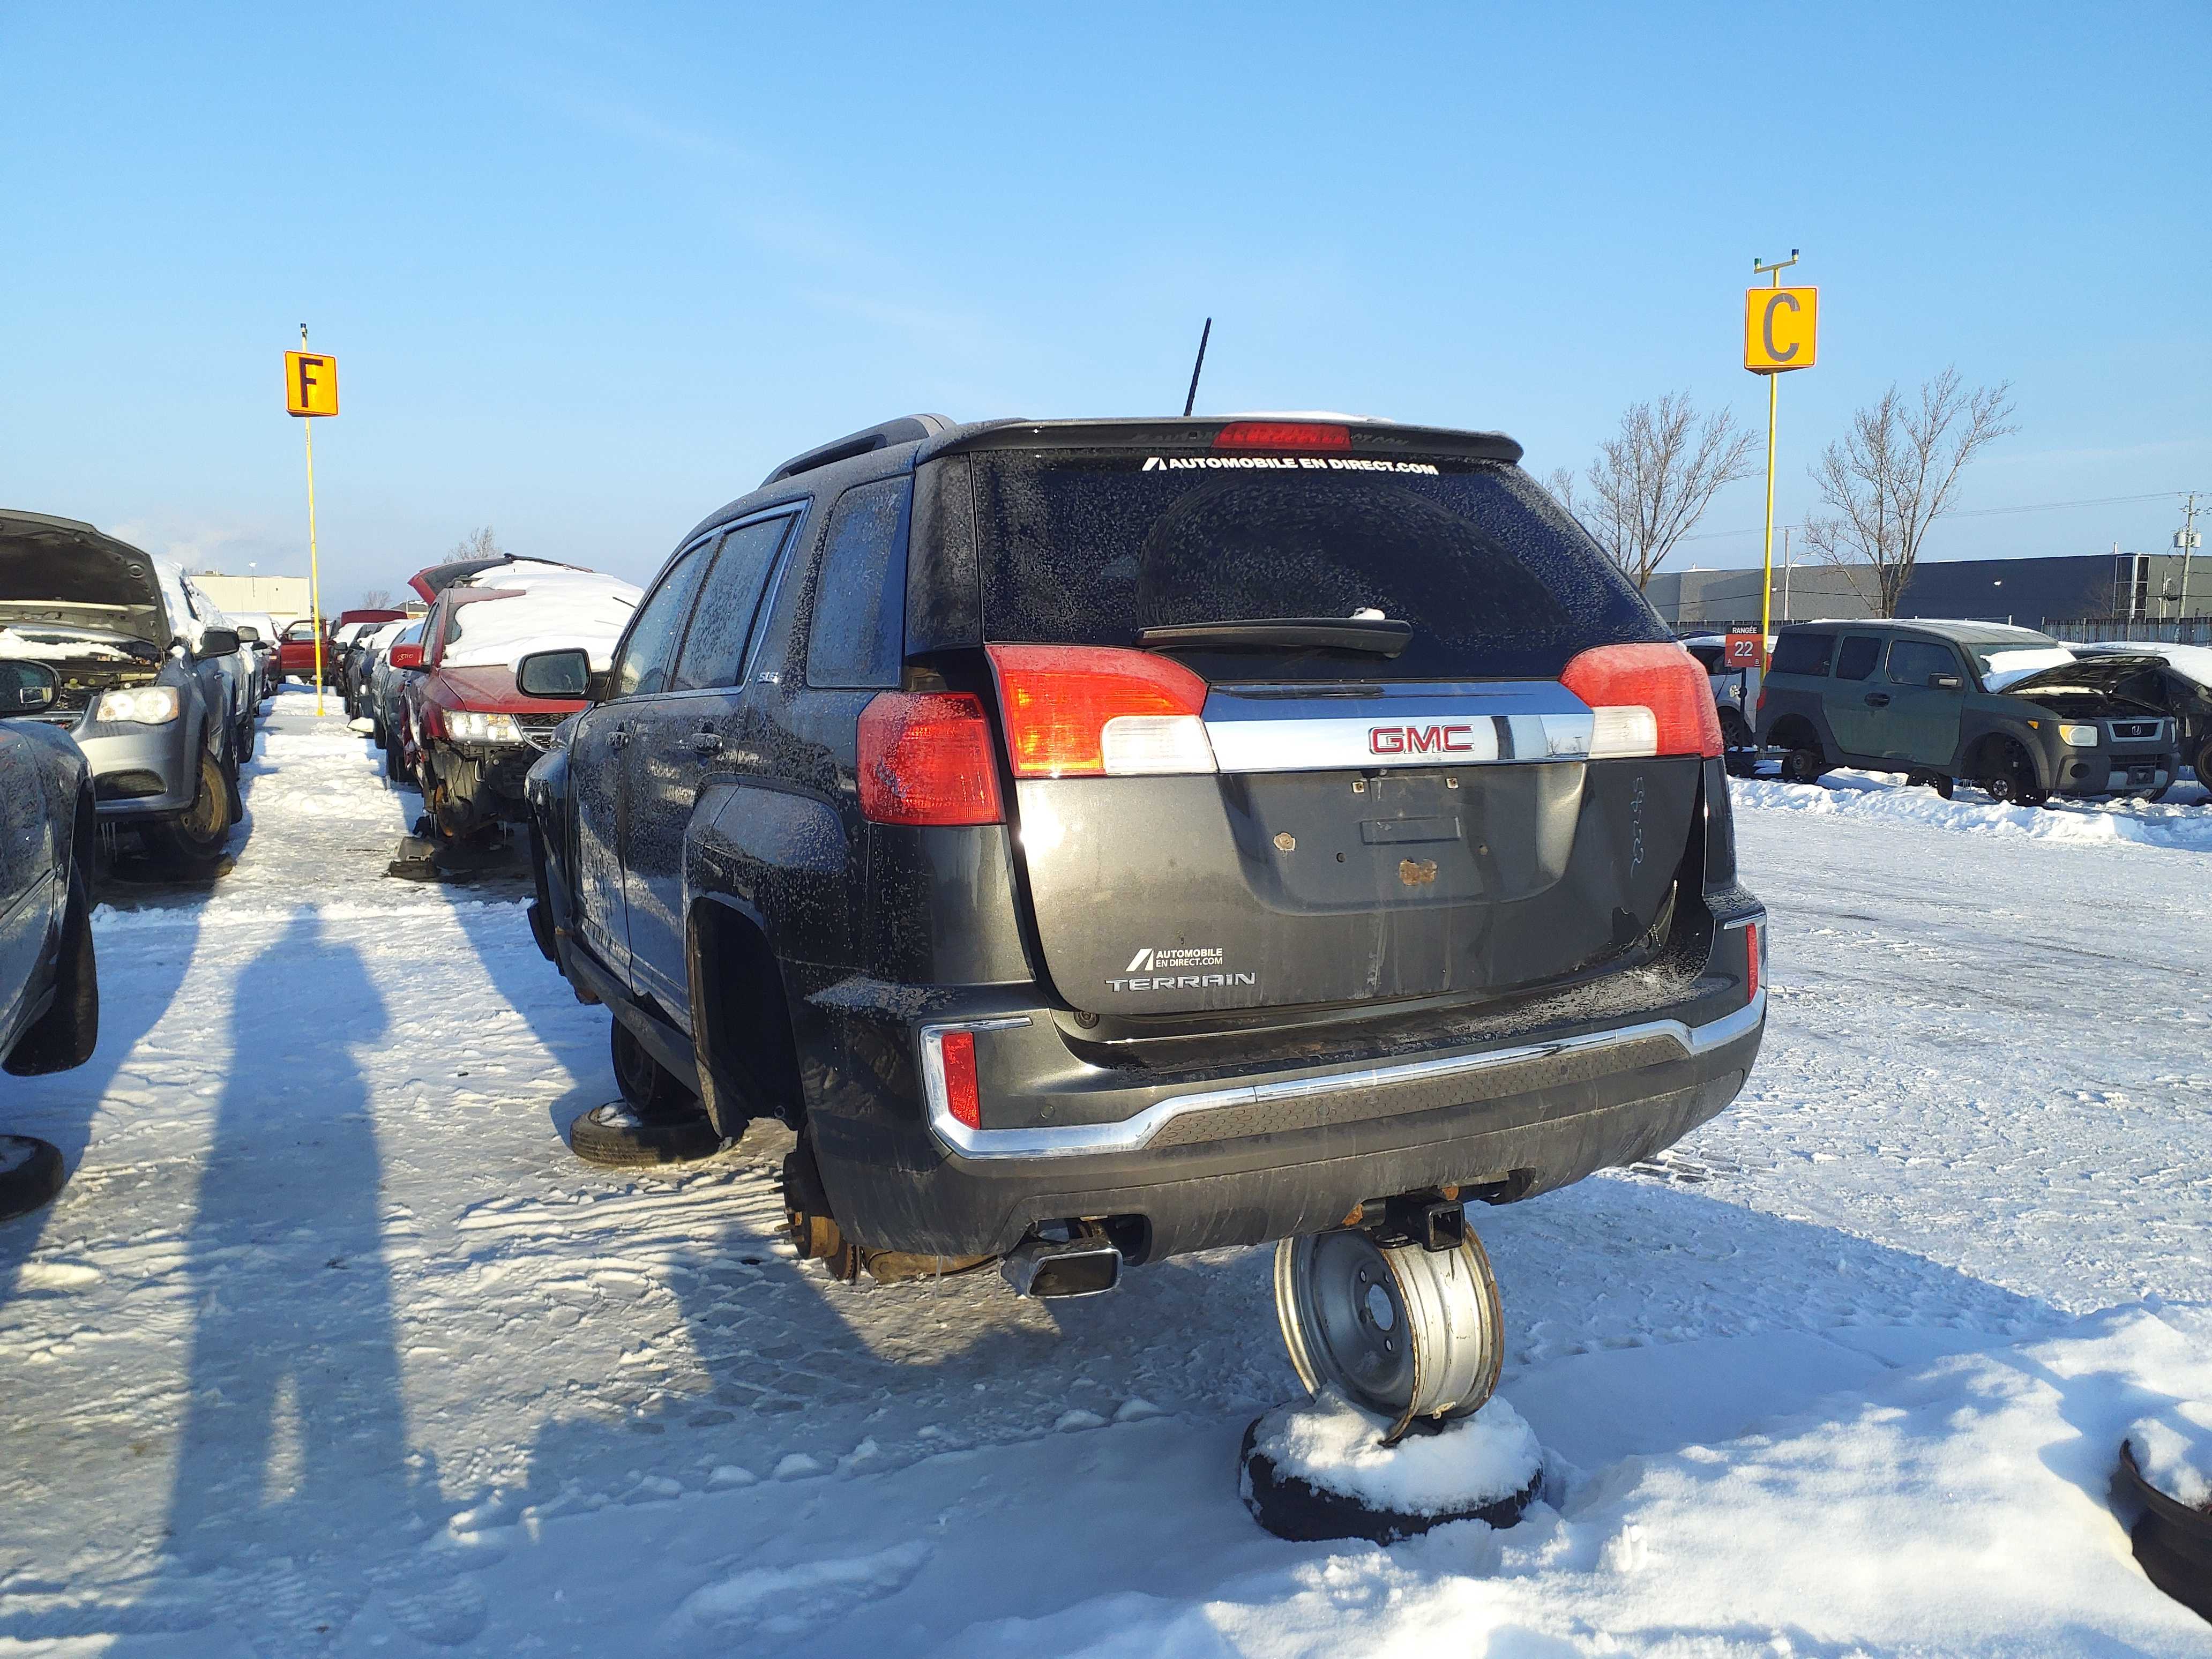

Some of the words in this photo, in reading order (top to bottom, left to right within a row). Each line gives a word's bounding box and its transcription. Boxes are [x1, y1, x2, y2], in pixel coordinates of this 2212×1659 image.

[1763, 293, 1800, 362] C
[298, 357, 324, 408] F
[1169, 458, 1298, 469] AUTOMOBILE
[1298, 459, 1328, 469] EN
[1327, 459, 1439, 475] DIRECT.COM
[1734, 641, 1753, 656] 22
[1369, 724, 1475, 754] GMC
[1156, 947, 1223, 958] AUTOMOBILE
[1156, 959, 1168, 967] EN
[1169, 956, 1223, 967] DIRECT.COM
[1105, 972, 1256, 992] TERRAIN
